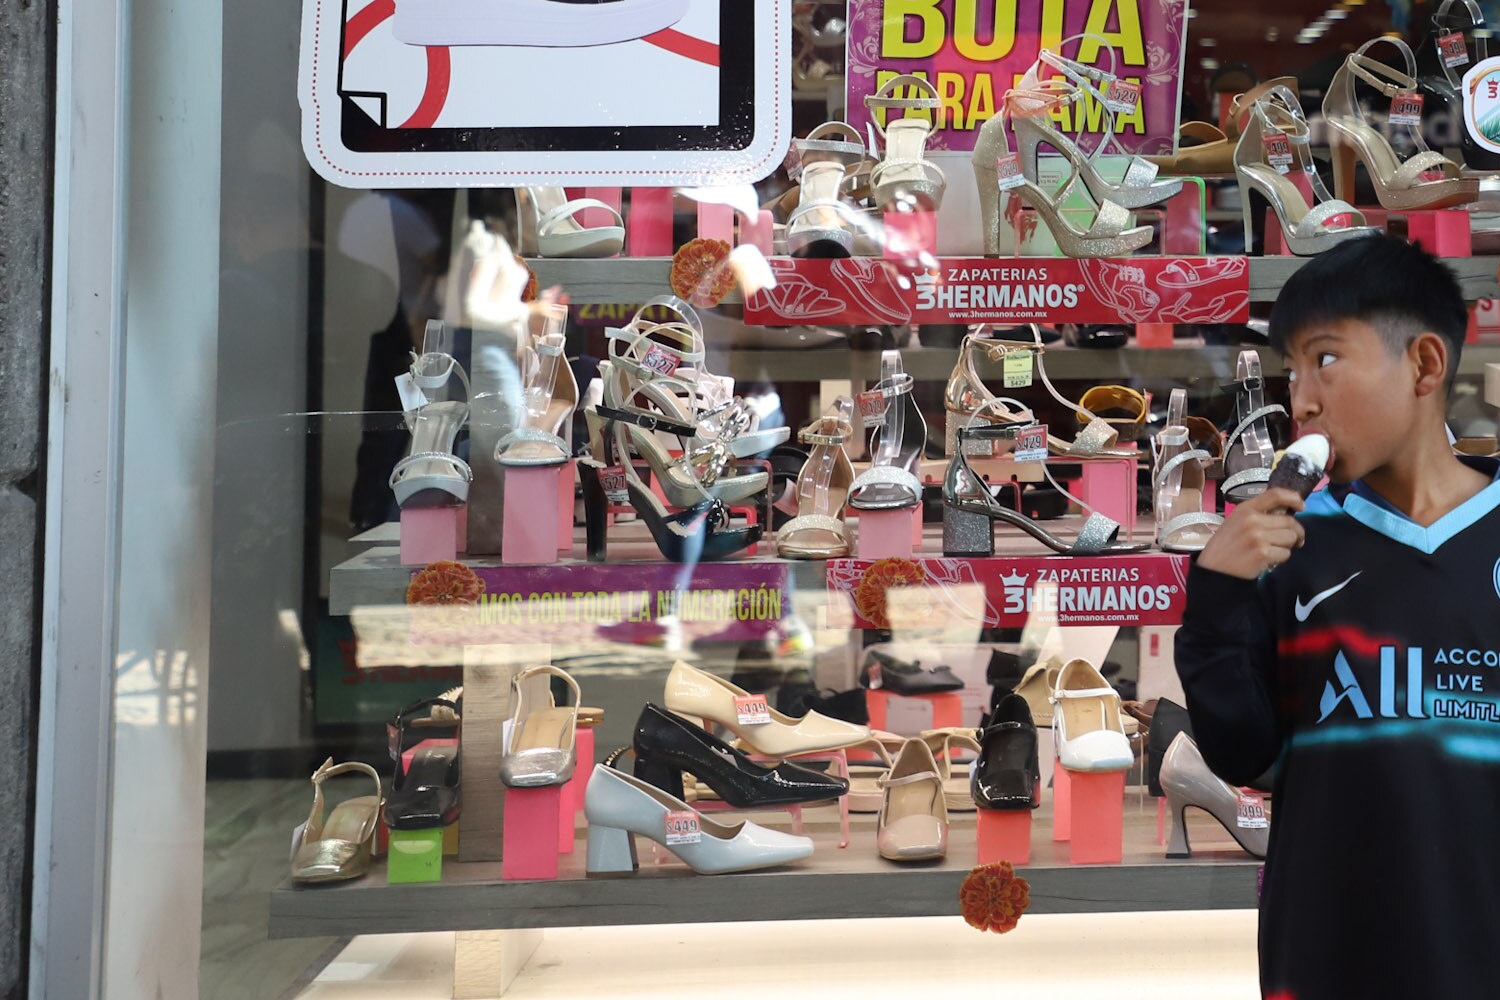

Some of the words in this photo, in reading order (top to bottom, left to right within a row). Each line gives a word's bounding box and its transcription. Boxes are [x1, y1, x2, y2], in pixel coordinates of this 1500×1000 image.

[947, 267, 1048, 282] ZAPATERIAS
[948, 311, 1048, 319] www.3hermanos.com.mx
[1036, 567, 1140, 583] ZAPATERIAS
[527, 592, 568, 624] CON
[571, 591, 622, 624] TODA
[628, 590, 652, 623] LA
[1436, 673, 1484, 693] LIVE
[737, 702, 767, 716] $449
[666, 819, 698, 833] $449
